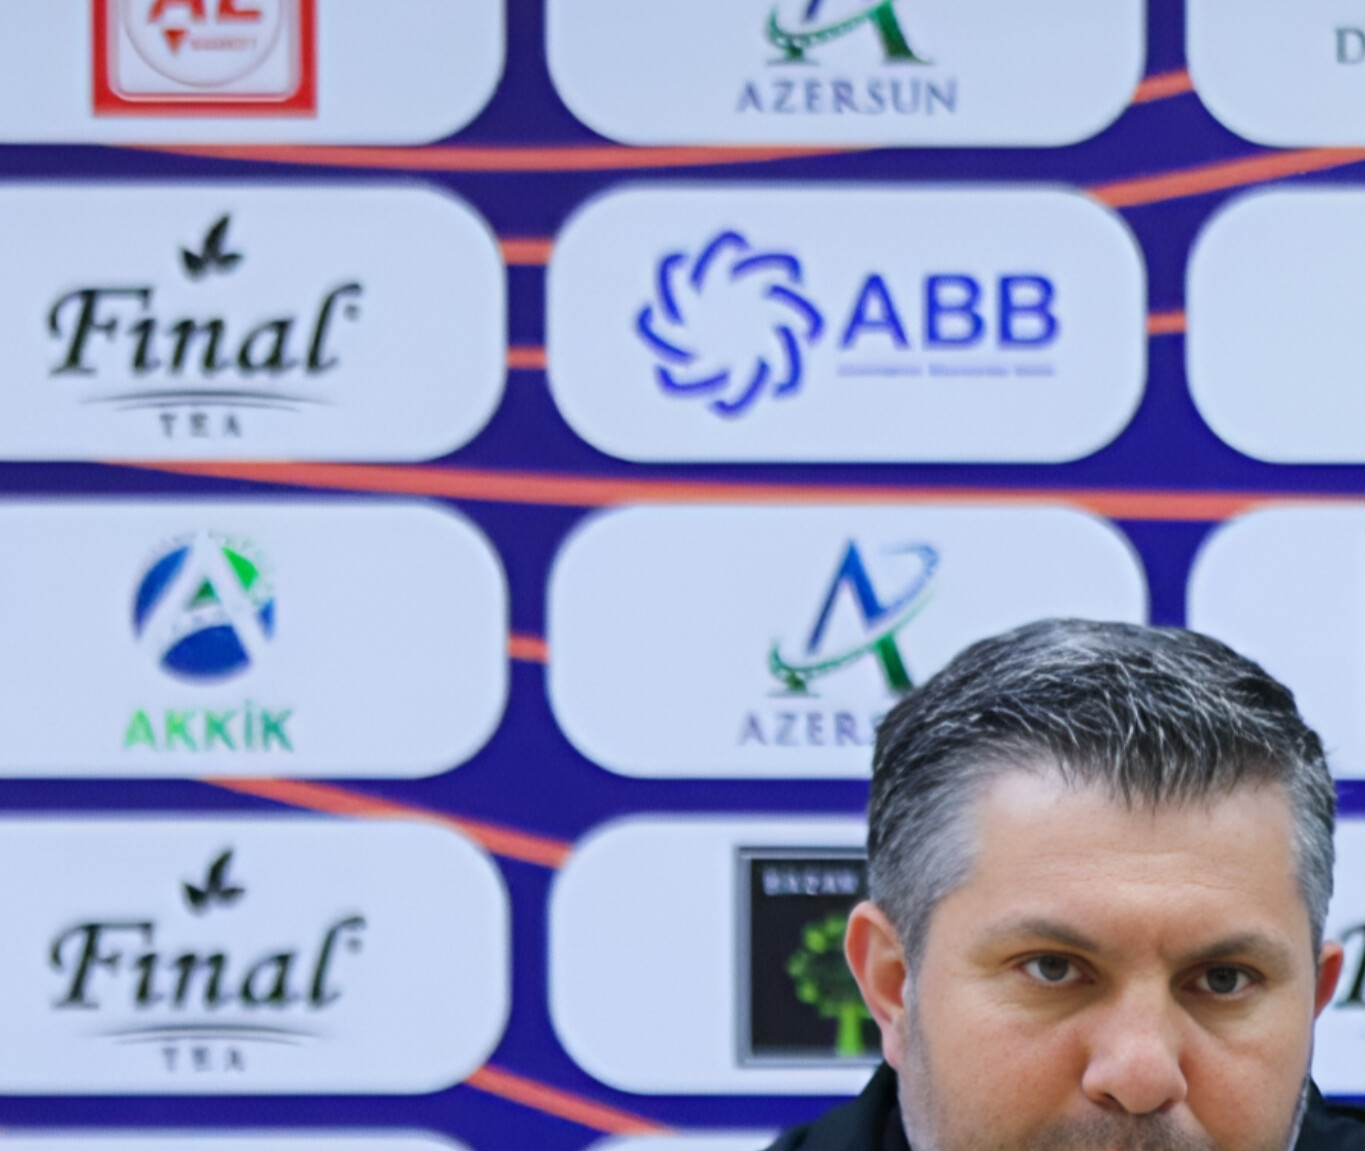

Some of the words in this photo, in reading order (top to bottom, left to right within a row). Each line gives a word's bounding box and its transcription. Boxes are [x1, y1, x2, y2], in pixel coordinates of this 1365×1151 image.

[738, 78, 956, 114] AZERSUN
[45, 281, 363, 379] Final
[837, 271, 1061, 351] ABB
[159, 412, 241, 437] TEA
[123, 700, 293, 752] AKKİK
[47, 916, 366, 1012] Final
[162, 1046, 243, 1071] TEA
